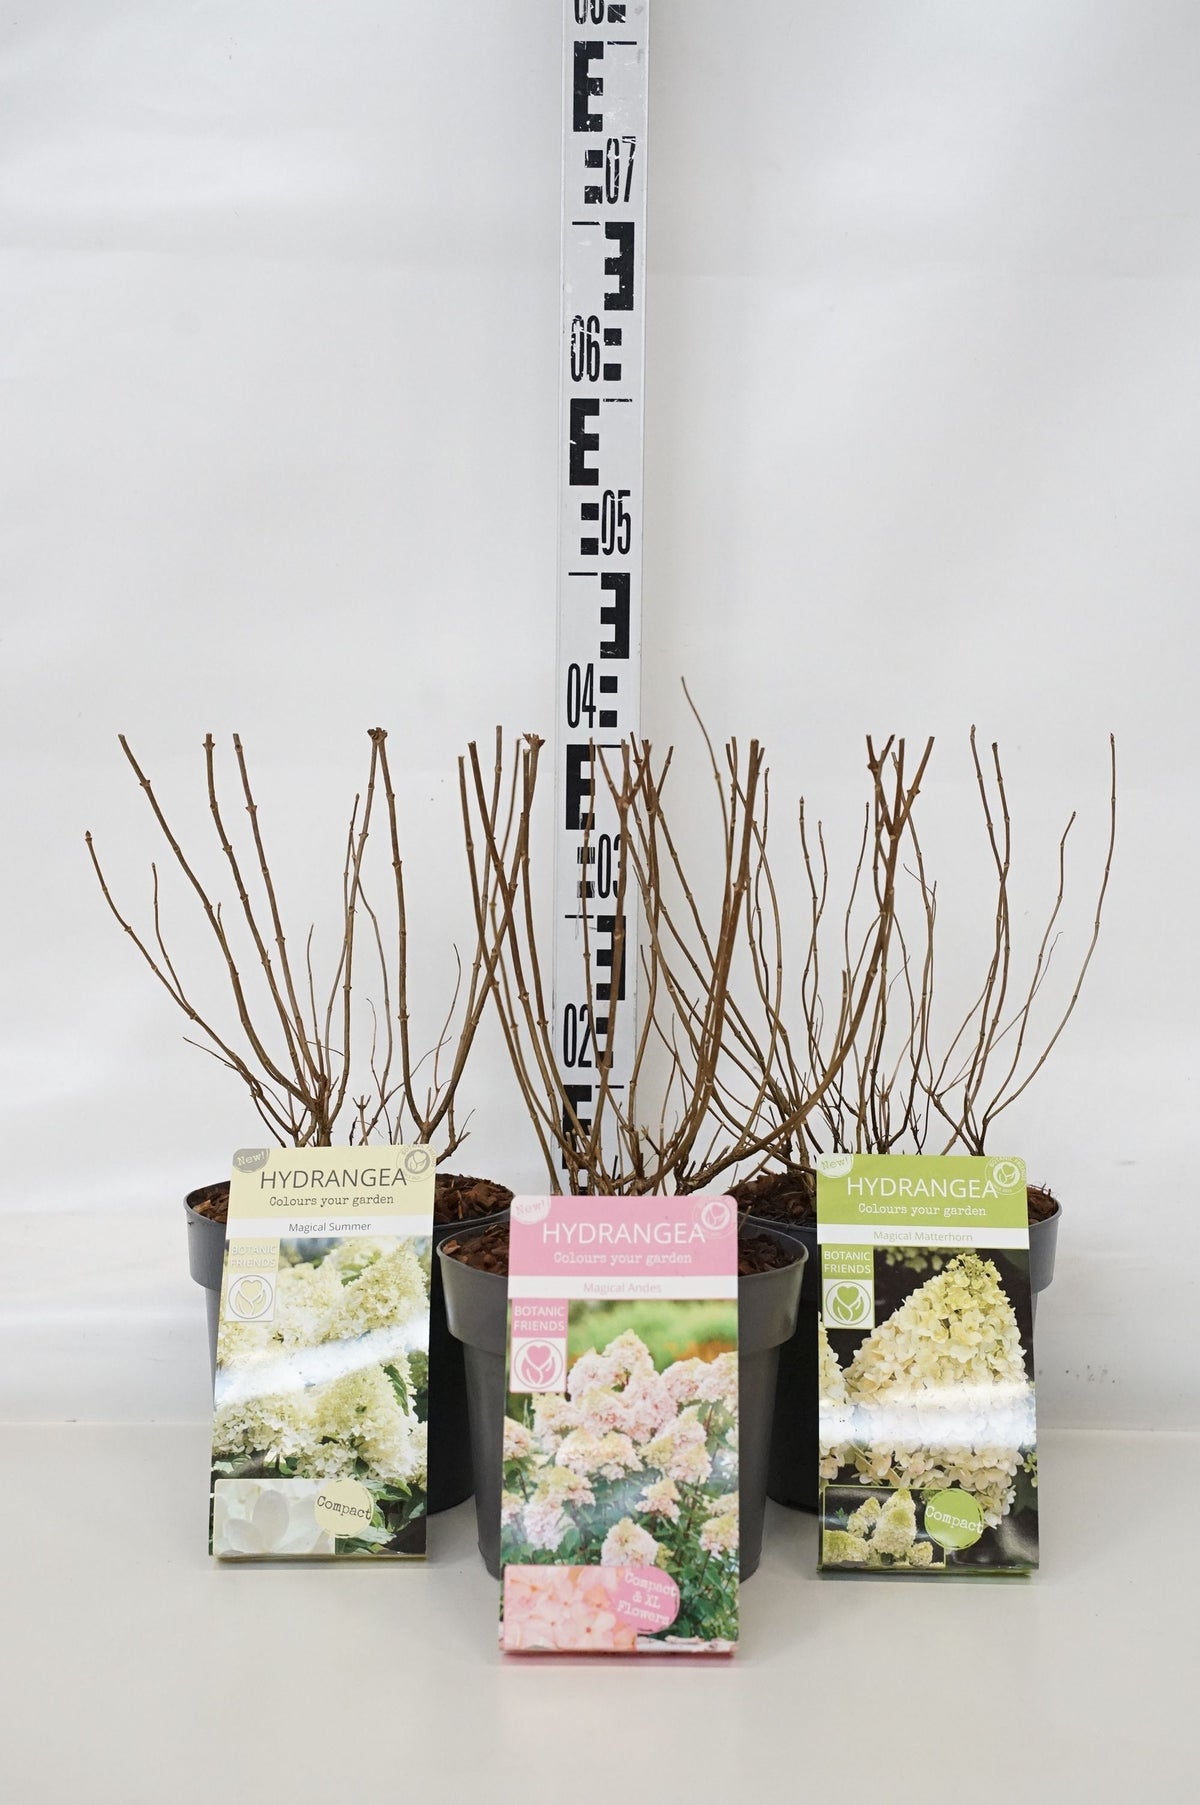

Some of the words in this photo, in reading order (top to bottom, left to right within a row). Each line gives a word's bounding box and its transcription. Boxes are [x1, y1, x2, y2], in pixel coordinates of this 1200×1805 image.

[605, 136, 636, 204] 07
[570, 315, 600, 382] 06
[601, 489, 631, 556] 05
[567, 663, 596, 729] 04
[236, 1150, 266, 1166] New!
[821, 1157, 849, 1171] New!
[260, 1168, 408, 1189] HYDRANGEA
[847, 1177, 999, 1199] HYDRANGEA
[269, 1196, 317, 1207] Colours
[320, 1197, 349, 1208] your
[352, 1194, 394, 1207] garden
[858, 1203, 908, 1215] Colours
[911, 1205, 940, 1217] your
[943, 1205, 987, 1217] garden
[288, 1222, 326, 1234] Magical
[329, 1222, 371, 1232] Summer
[543, 1223, 706, 1244] HYDRANGEA
[873, 1231, 912, 1242] Magical
[914, 1231, 973, 1242] Matterhorn
[553, 1251, 607, 1264] Colours
[610, 1254, 642, 1266] your
[646, 1252, 692, 1266] garden
[824, 1251, 870, 1261] BOTANIC
[824, 1264, 871, 1274] FRIENDS
[583, 1282, 625, 1295] Magical
[628, 1282, 662, 1294] Andes
[514, 1305, 565, 1317] BOTANIC
[513, 1320, 565, 1331] FRIENDS
[317, 1495, 372, 1520] Compact
[925, 1505, 983, 1534] Compact
[625, 1571, 677, 1597] Compact
[644, 1594, 661, 1609] XL
[617, 1600, 670, 1626] Flowers
